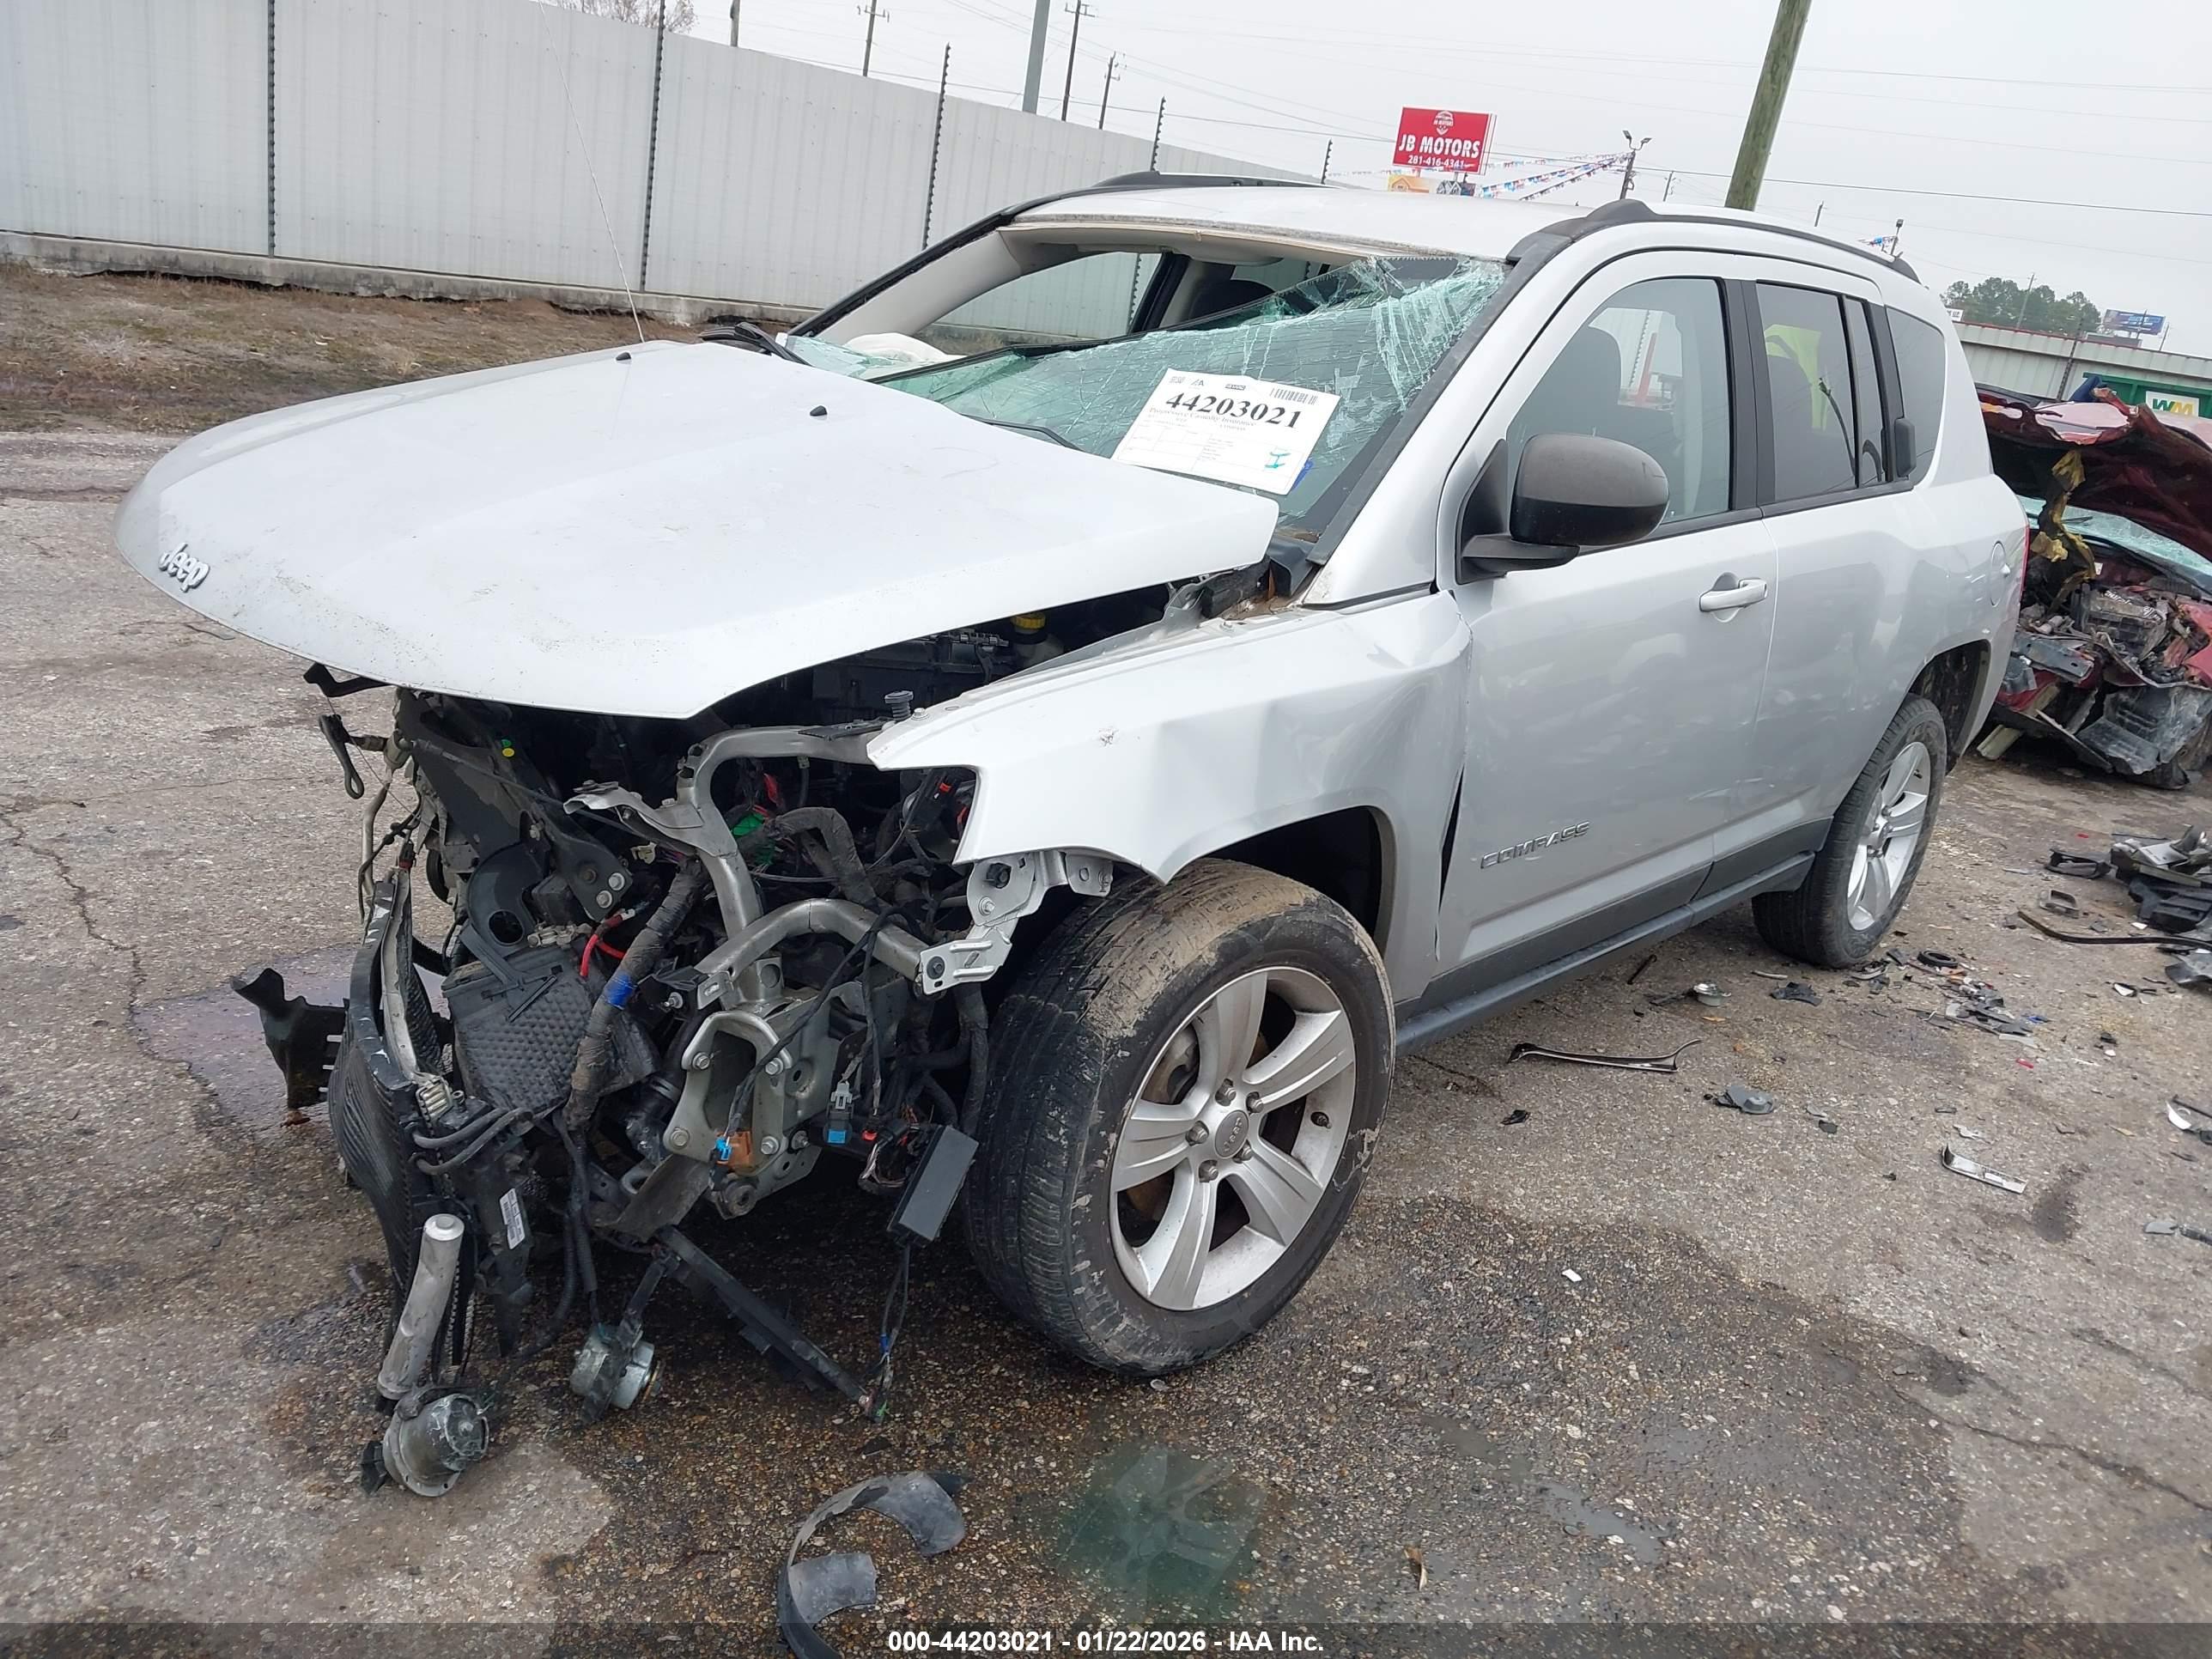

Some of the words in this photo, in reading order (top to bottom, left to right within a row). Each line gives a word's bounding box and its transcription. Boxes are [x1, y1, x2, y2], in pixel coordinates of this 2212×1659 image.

[1398, 134, 1416, 152] JB
[1419, 136, 1480, 159] MOTORS
[1165, 392, 1302, 428] 44203021
[2152, 398, 2194, 416] WM
[158, 543, 210, 593] Jeep
[1480, 821, 1589, 869] COMPASS
